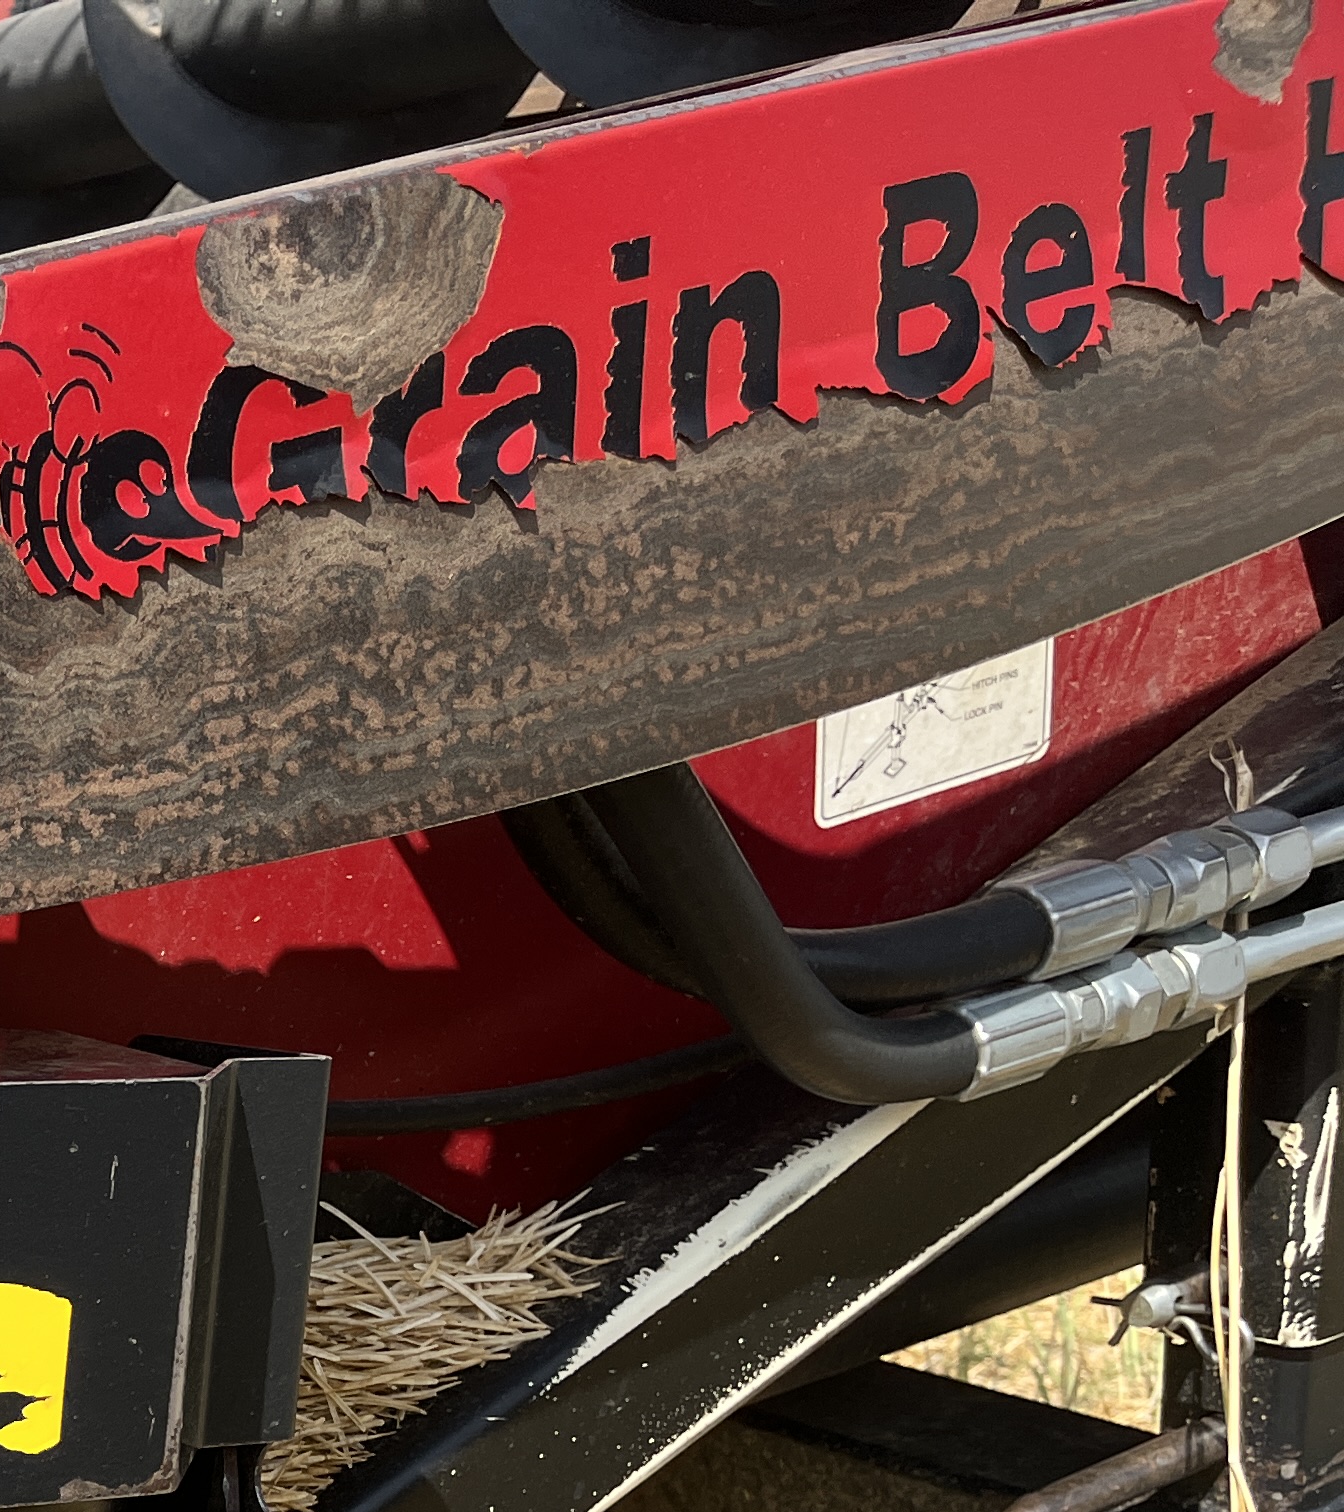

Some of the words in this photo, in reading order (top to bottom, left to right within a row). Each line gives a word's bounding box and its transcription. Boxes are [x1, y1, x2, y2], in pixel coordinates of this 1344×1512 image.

[185, 236, 782, 522] Grain
[876, 112, 1228, 402] Belt
[972, 675, 997, 690] HITCH
[999, 669, 1018, 682] PINS
[964, 706, 987, 721] LOCK
[988, 701, 1003, 713] PIN
